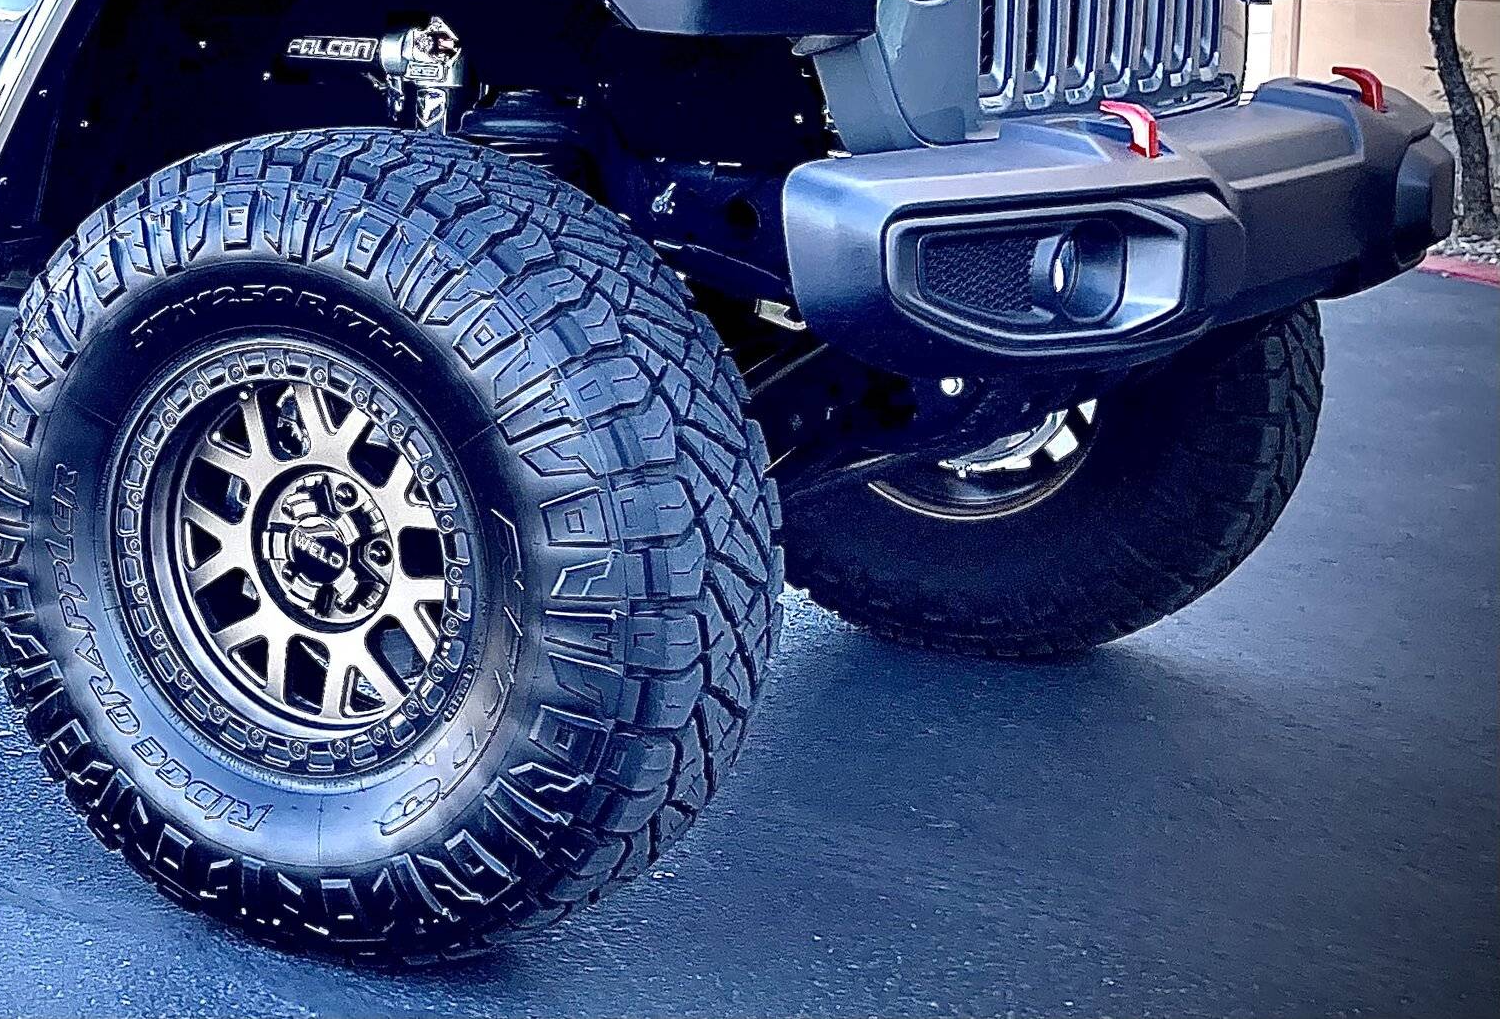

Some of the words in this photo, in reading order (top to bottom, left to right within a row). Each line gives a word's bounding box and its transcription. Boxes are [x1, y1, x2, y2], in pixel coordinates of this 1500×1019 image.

[287, 39, 372, 59] FALCON
[292, 529, 344, 570] WELD
[45, 462, 143, 736] GRAPPLER
[131, 735, 276, 833] RIDGE
